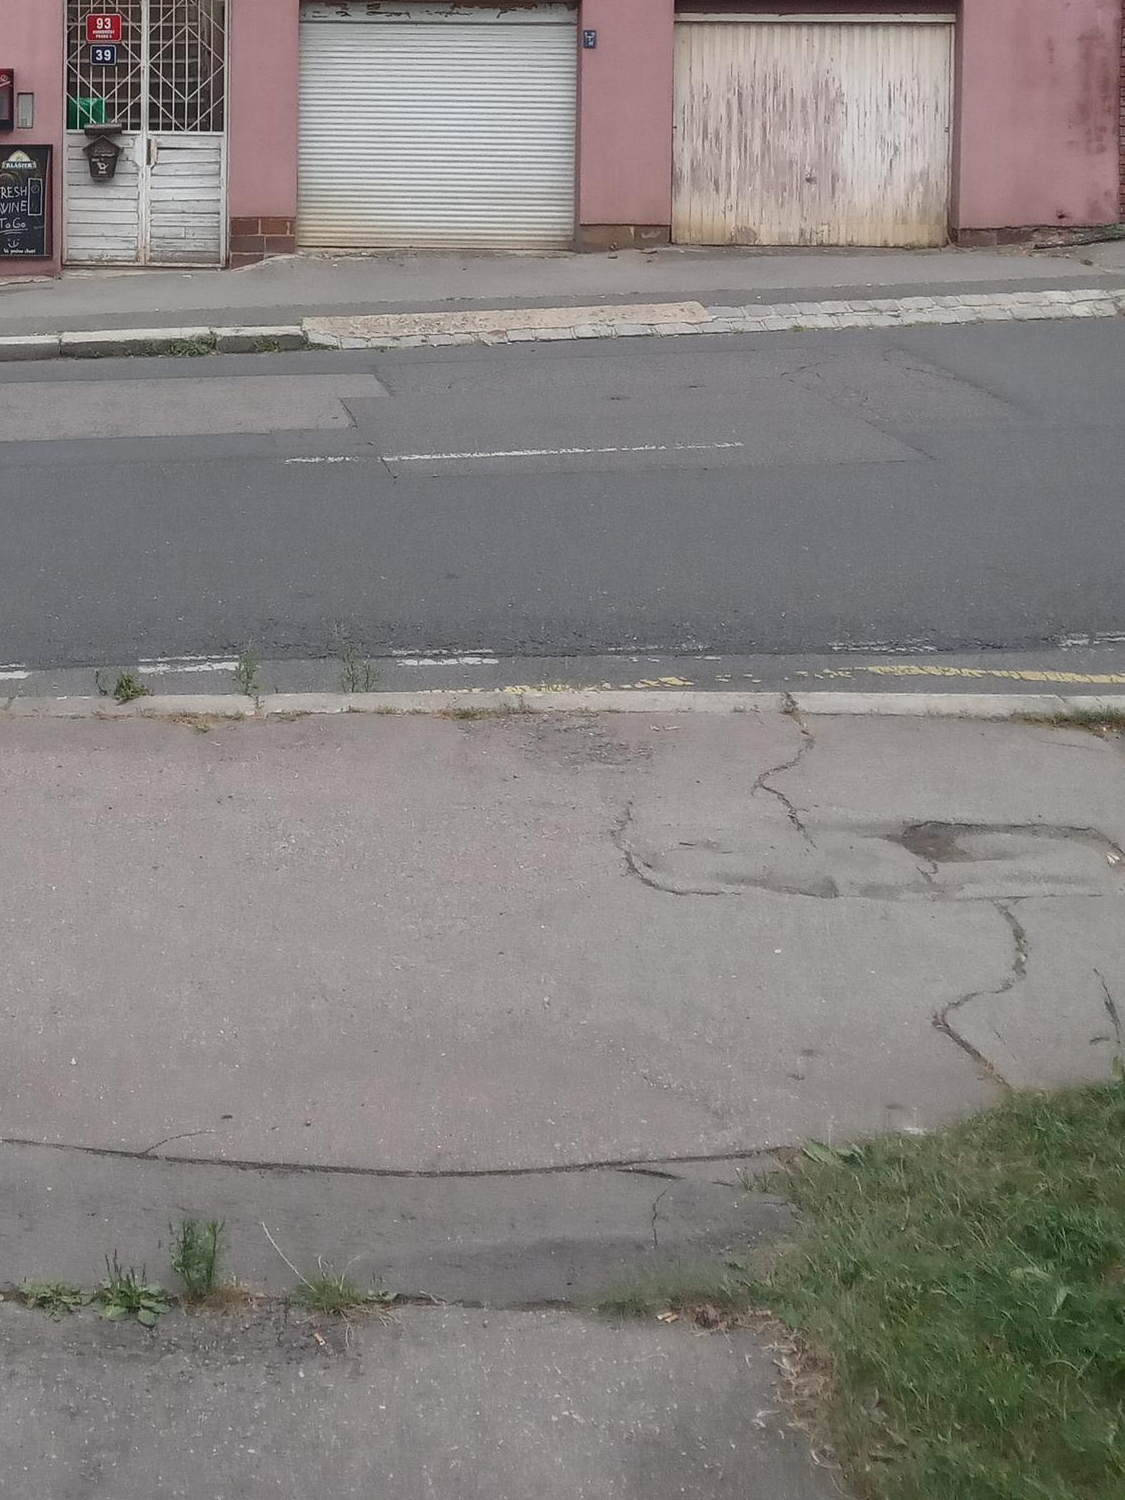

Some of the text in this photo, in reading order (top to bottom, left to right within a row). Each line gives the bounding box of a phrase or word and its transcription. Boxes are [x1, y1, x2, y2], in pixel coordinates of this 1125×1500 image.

[96, 17, 112, 30] 93
[95, 49, 111, 61] 39
[12, 217, 27, 229] Go
